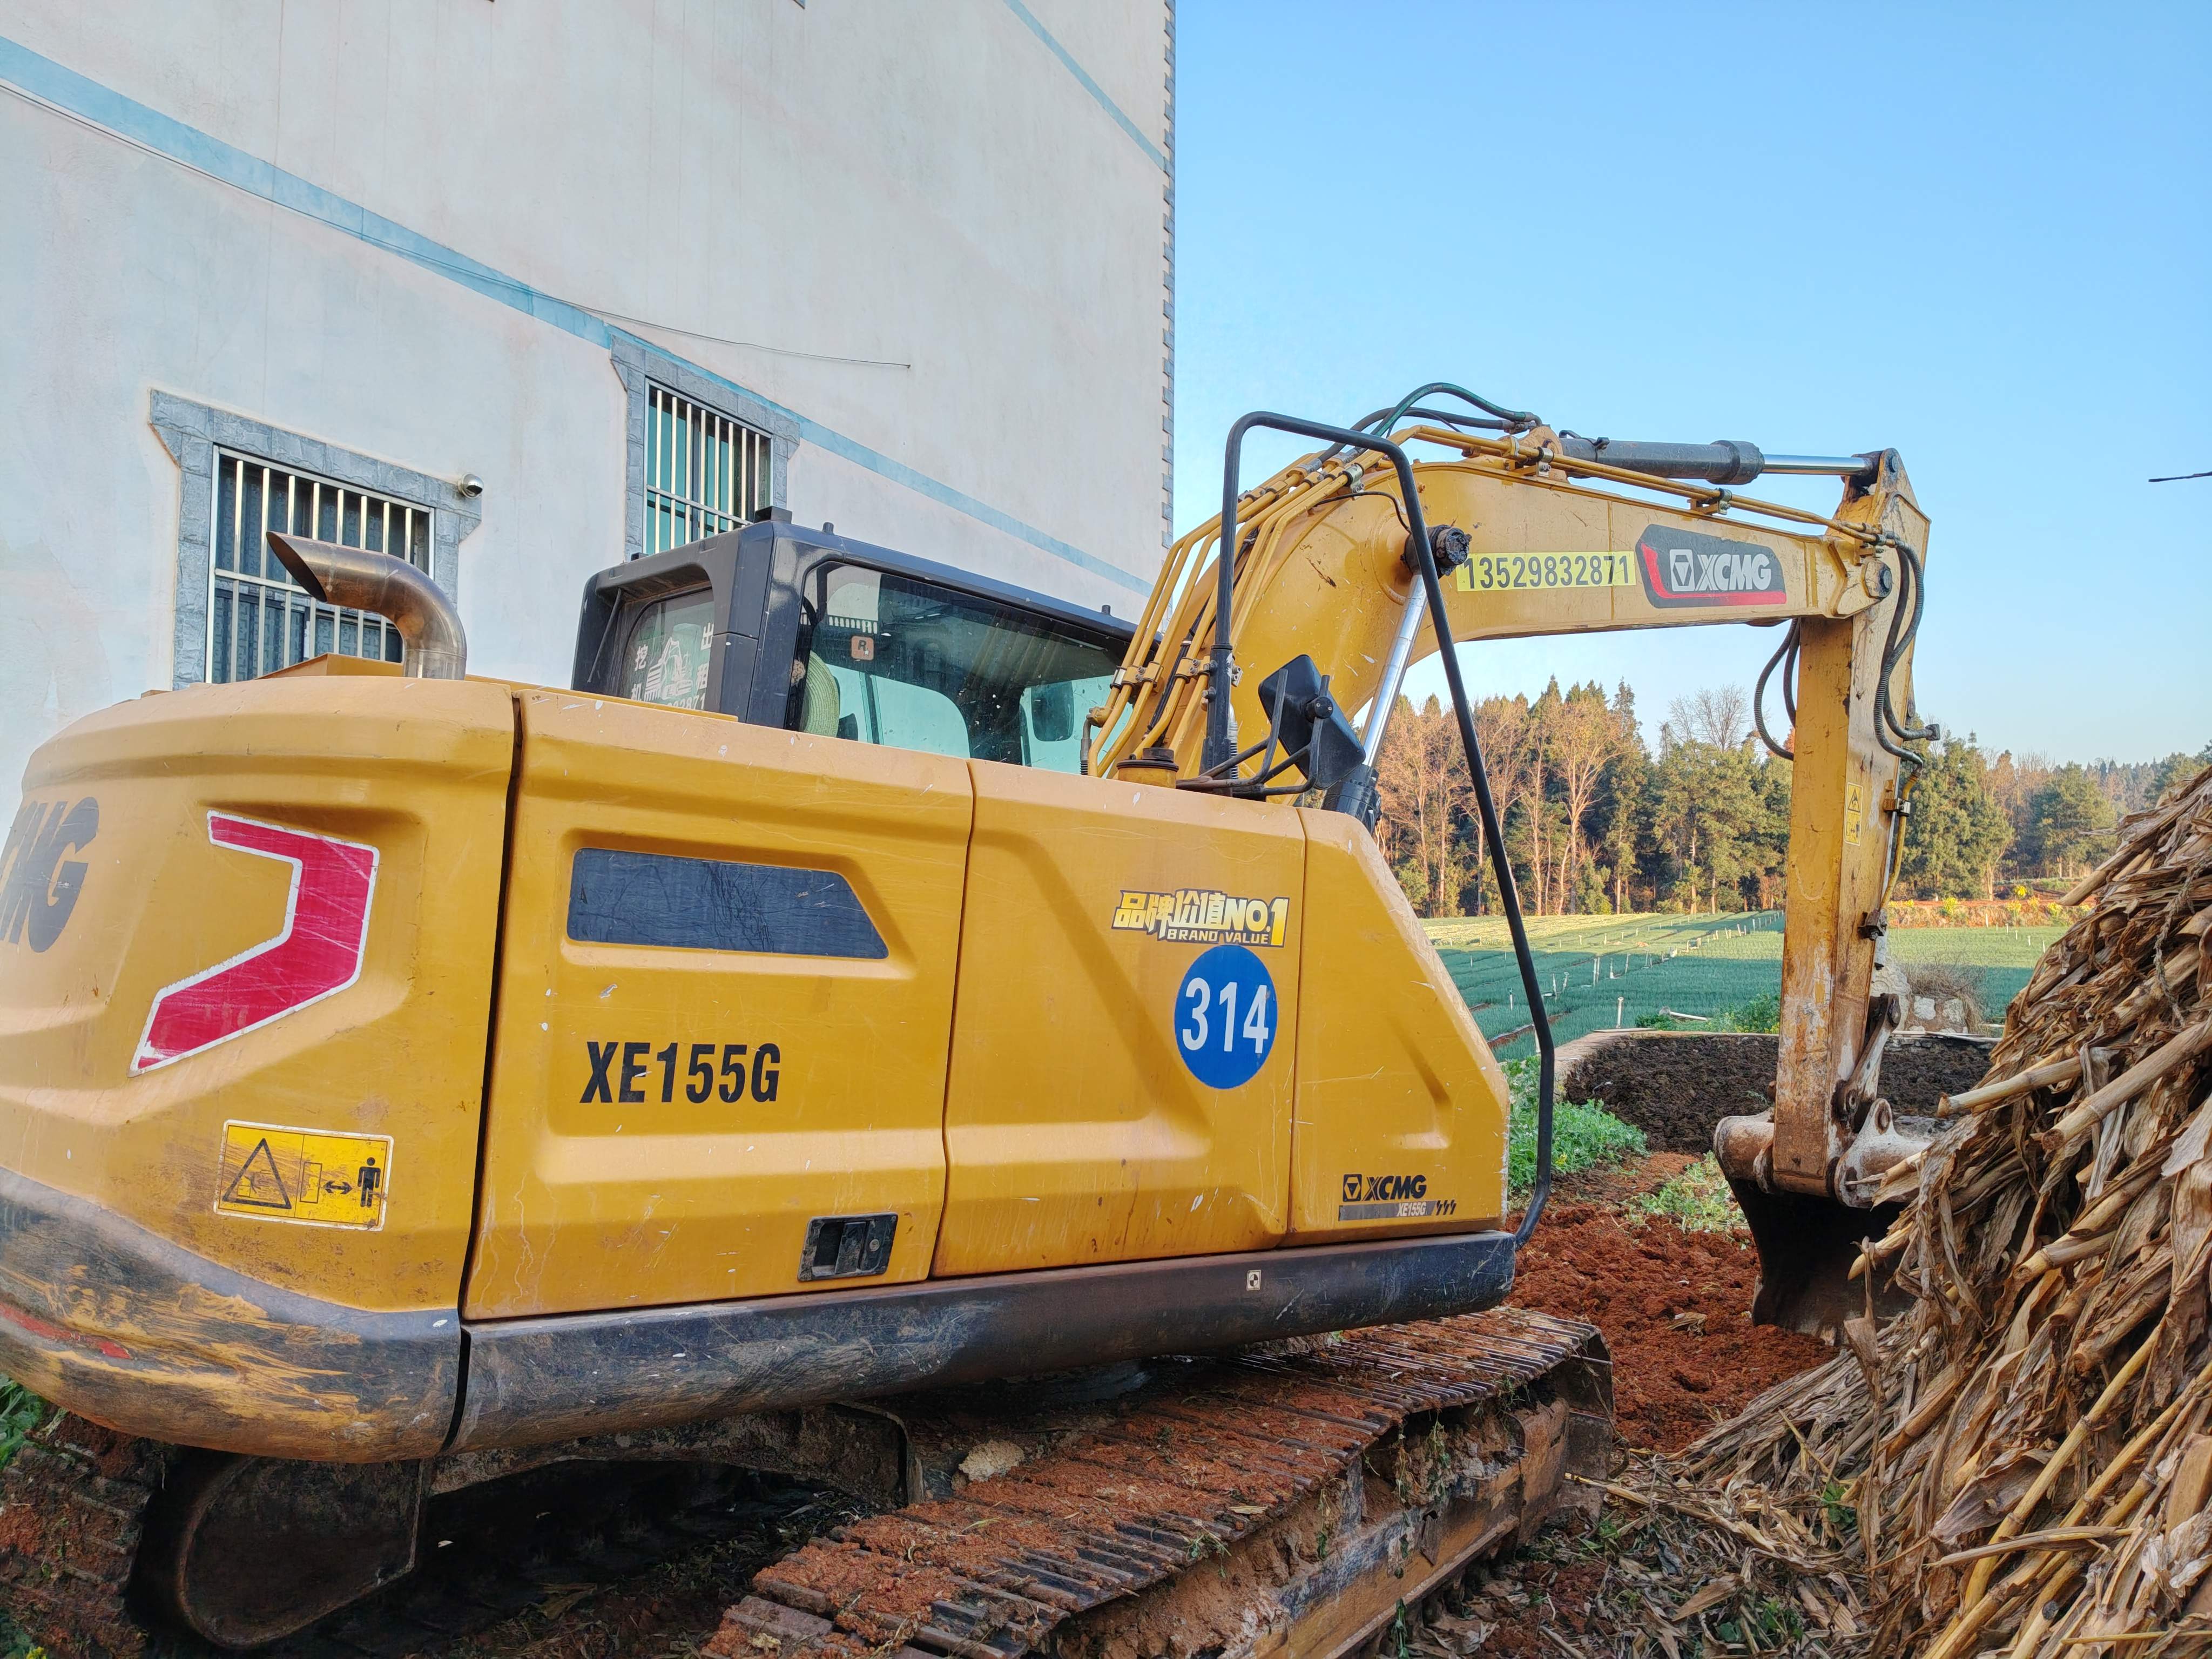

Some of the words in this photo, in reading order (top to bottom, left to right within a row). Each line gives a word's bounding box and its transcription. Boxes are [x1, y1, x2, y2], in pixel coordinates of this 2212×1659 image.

[1464, 555, 1629, 589] 13529832871
[1695, 553, 1771, 591] XCMG
[1167, 928, 1218, 942] BRAND
[1225, 932, 1269, 945] VALUE
[1182, 977, 1269, 1054] 314
[579, 1041, 781, 1104] XE155G
[1361, 1175, 1427, 1201] XCMG
[1397, 1202, 1427, 1217] XE155G
